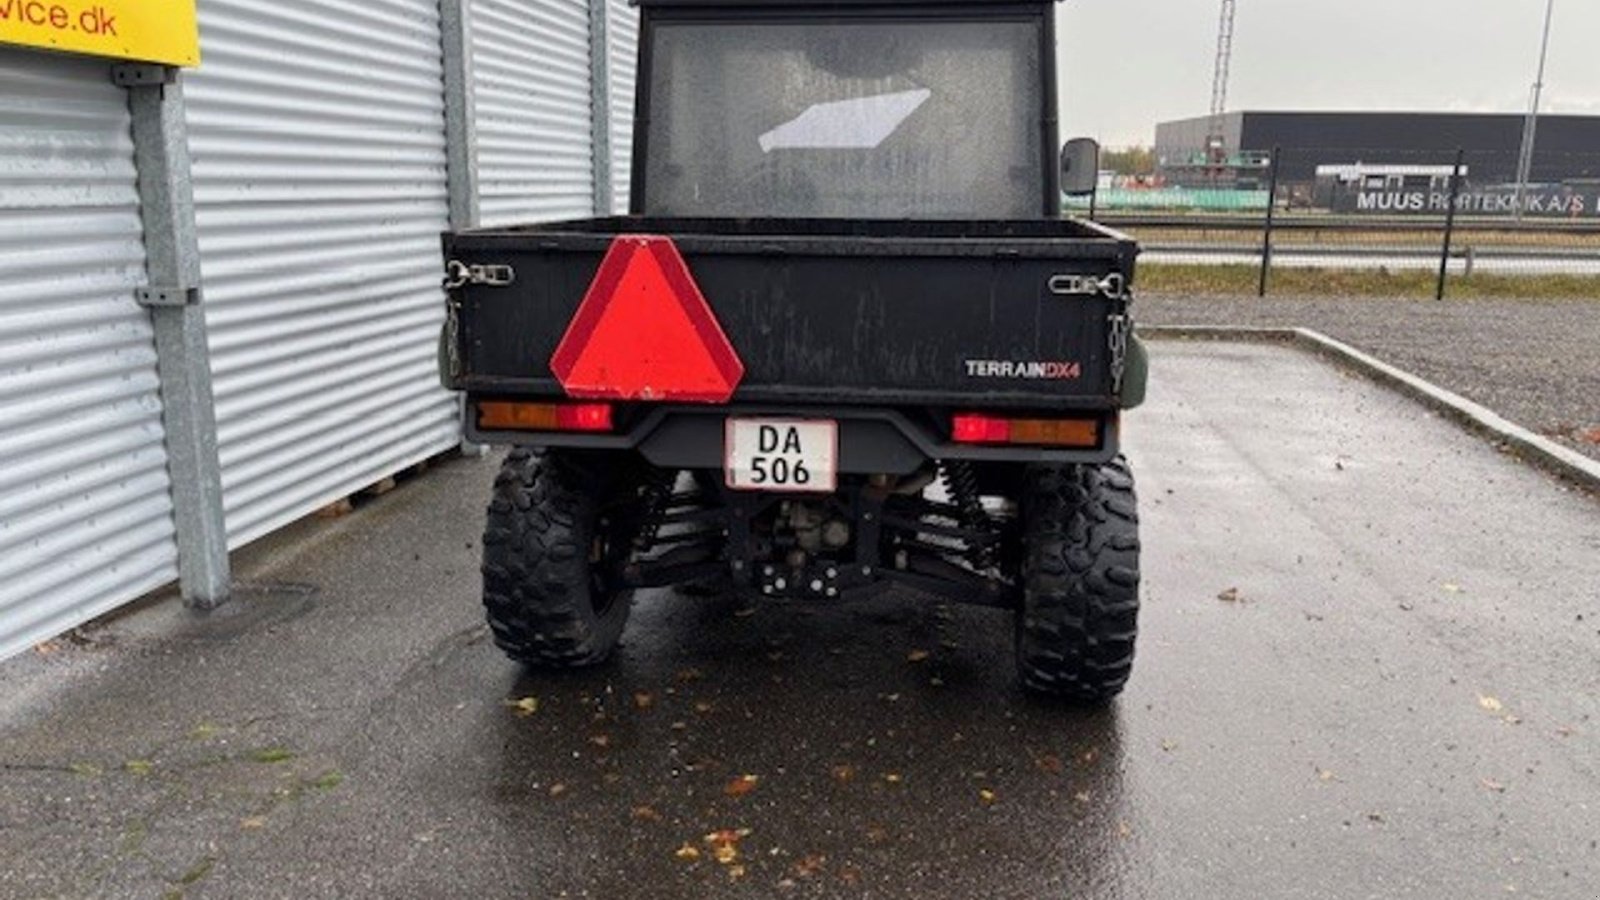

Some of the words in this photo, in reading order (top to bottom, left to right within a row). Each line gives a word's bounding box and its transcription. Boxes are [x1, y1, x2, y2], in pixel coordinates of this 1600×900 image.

[1357, 192, 1425, 210] MUUS
[759, 425, 801, 454] DA
[751, 457, 810, 485] 506
